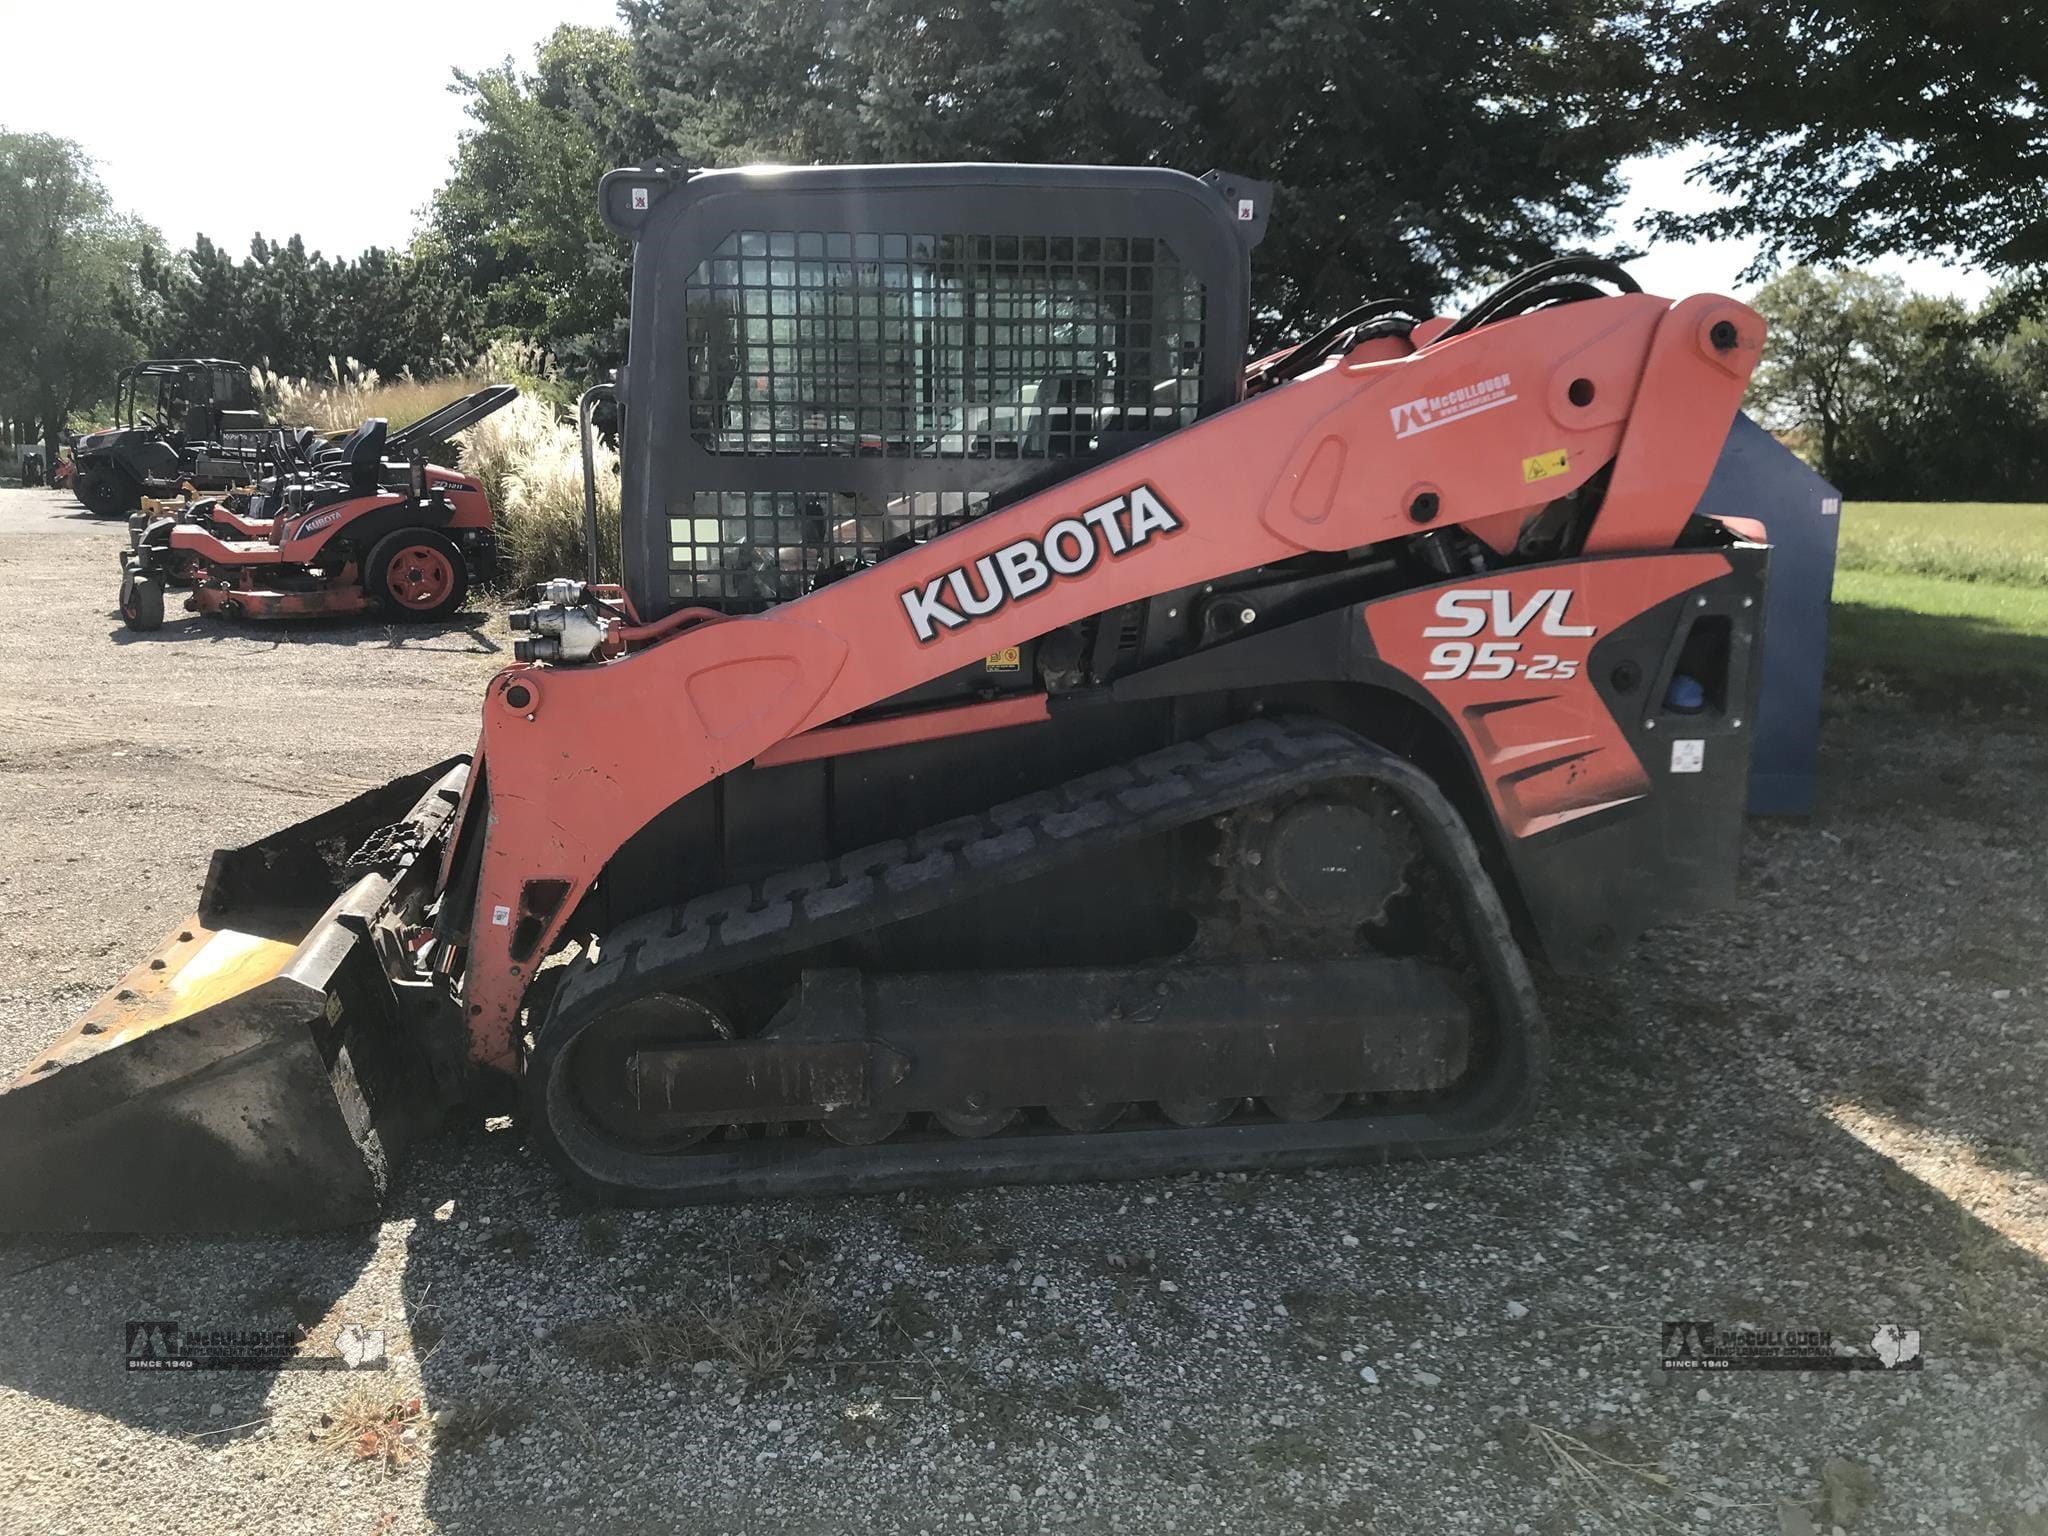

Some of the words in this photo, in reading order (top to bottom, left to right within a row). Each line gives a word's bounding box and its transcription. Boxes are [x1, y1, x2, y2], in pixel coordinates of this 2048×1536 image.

[305, 511, 342, 532] KUBOTA
[900, 485, 1179, 642] KUBOTA
[1422, 589, 1597, 638] SVL
